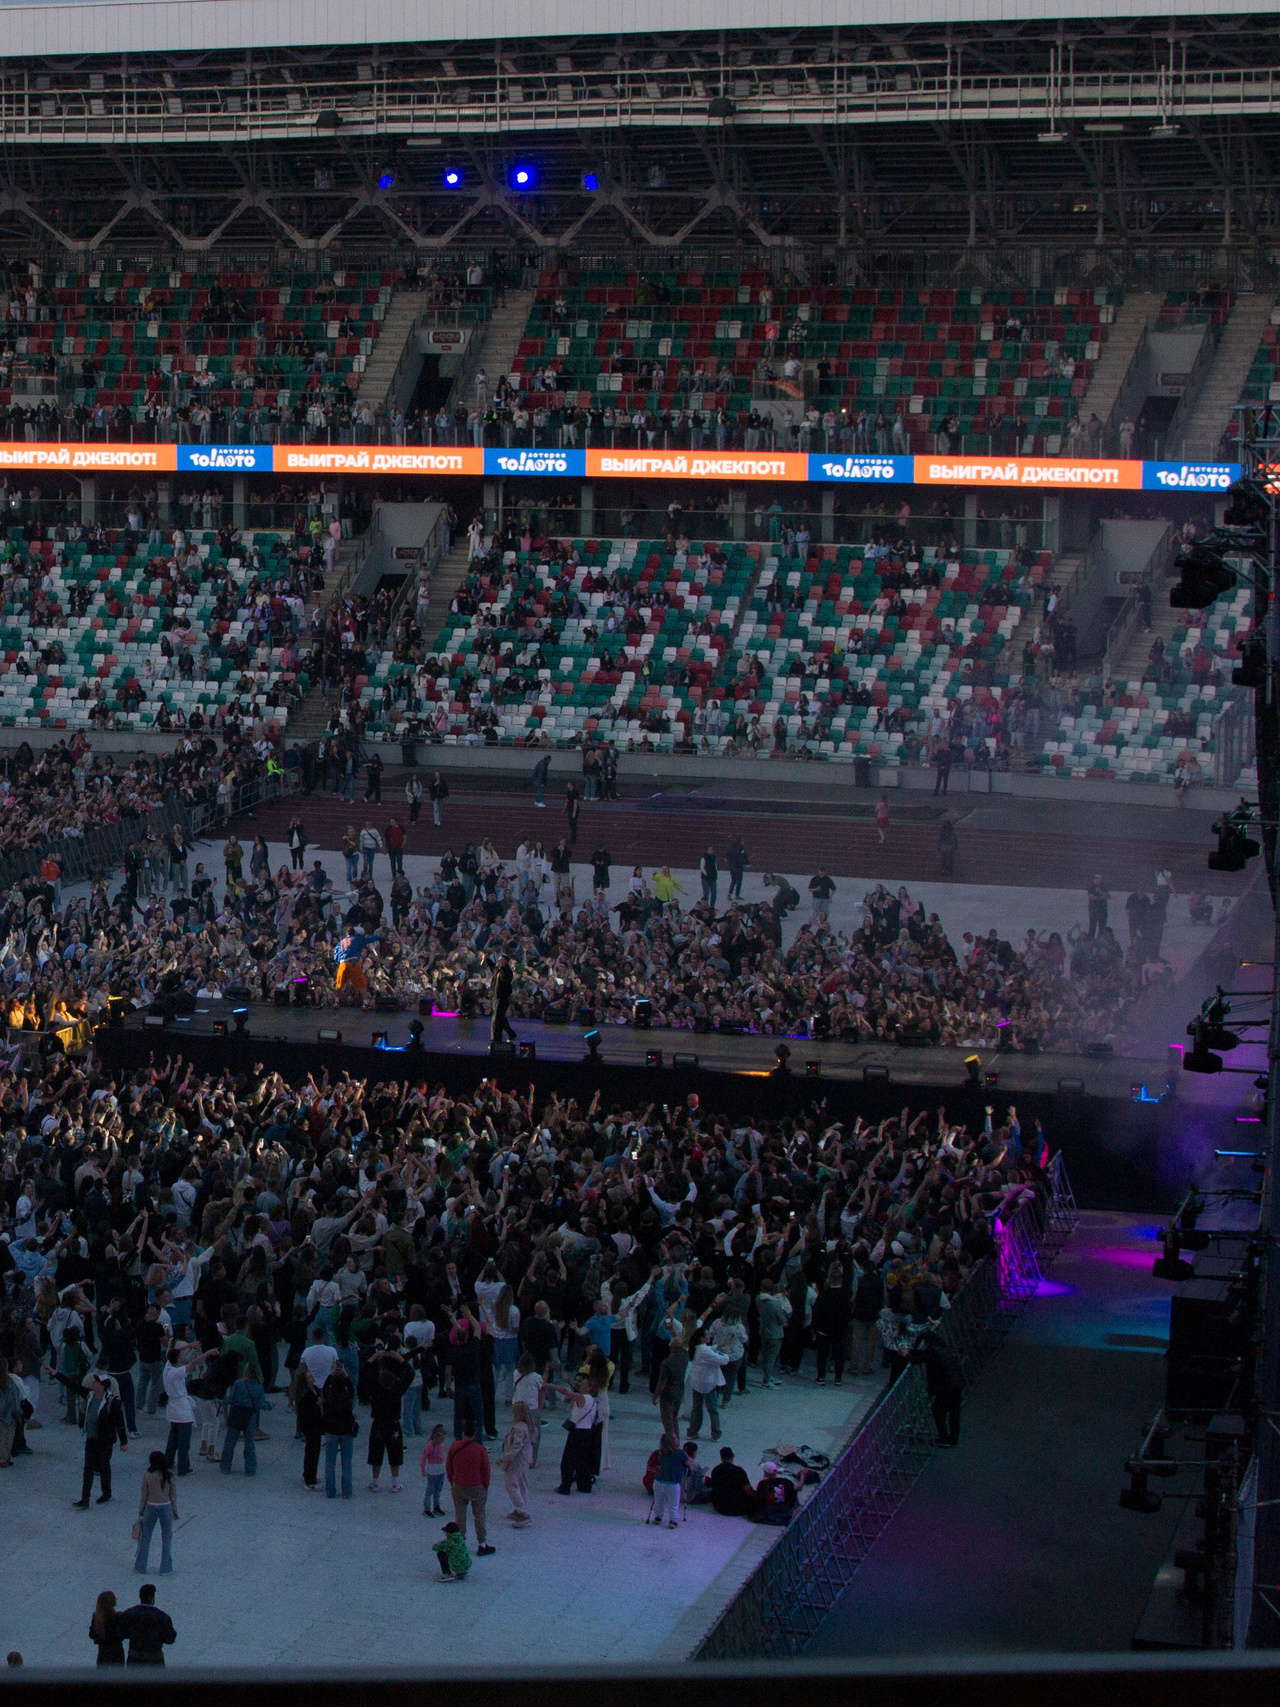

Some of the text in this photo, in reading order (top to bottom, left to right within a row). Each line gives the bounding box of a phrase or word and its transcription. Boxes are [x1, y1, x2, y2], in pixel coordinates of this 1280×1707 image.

[73, 452, 156, 466] ДЖЕКПОТ!
[288, 452, 462, 470] ВЫИГРАЙ ДЖЕКПОТ!
[601, 456, 785, 475] ВЫИГРАЙ ДЖЕКПОТ!
[930, 463, 1119, 483] ВЫИГРАЙ ДЖЕКПОТ!
